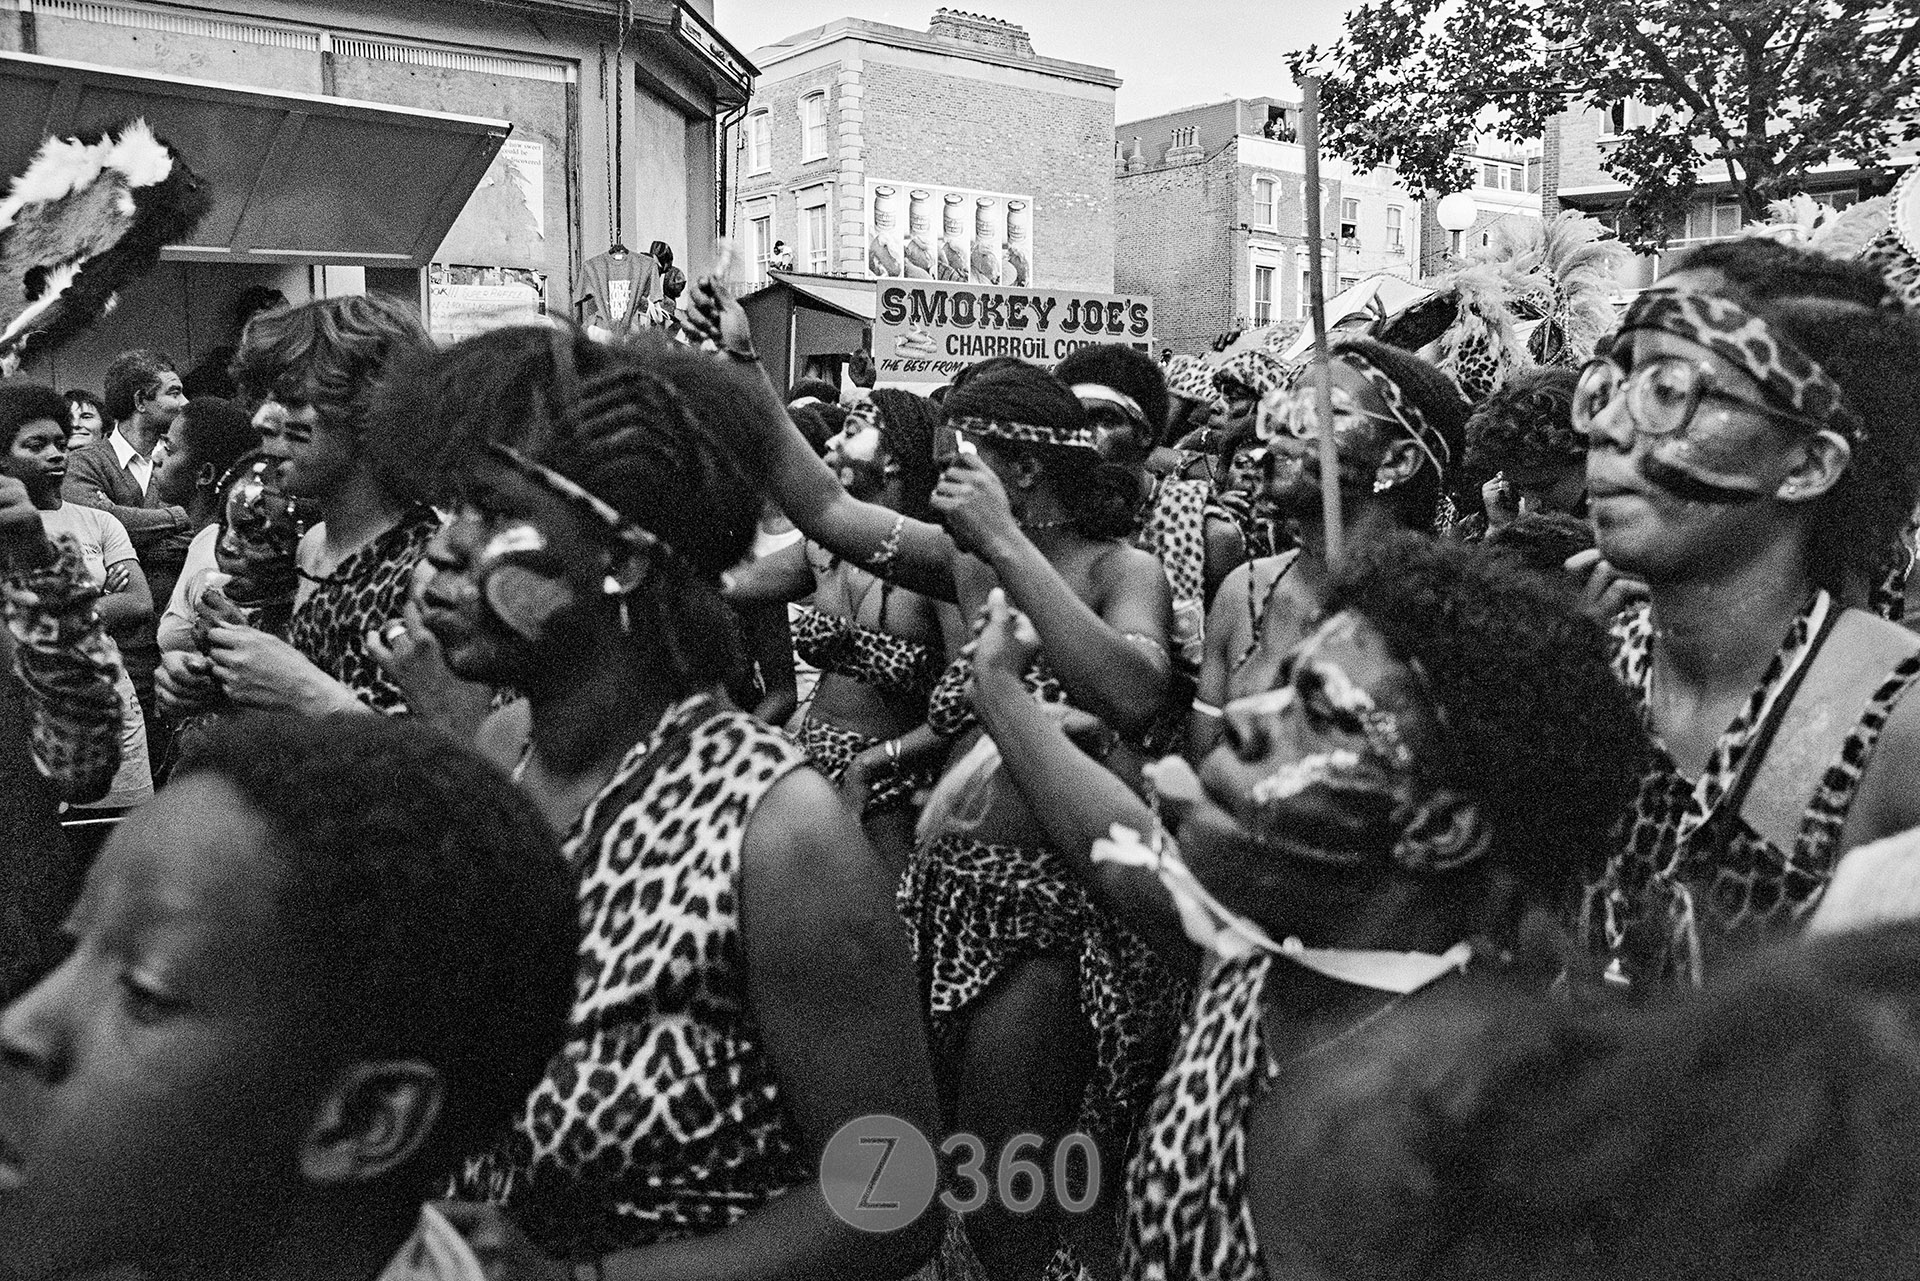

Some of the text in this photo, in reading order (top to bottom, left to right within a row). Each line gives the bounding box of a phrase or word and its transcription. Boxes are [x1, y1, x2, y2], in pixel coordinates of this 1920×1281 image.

[880, 286, 1151, 338] SMOKEY JOE'S
[880, 358, 904, 371] THE
[903, 359, 932, 372] BEST
[931, 360, 964, 376] FROM
